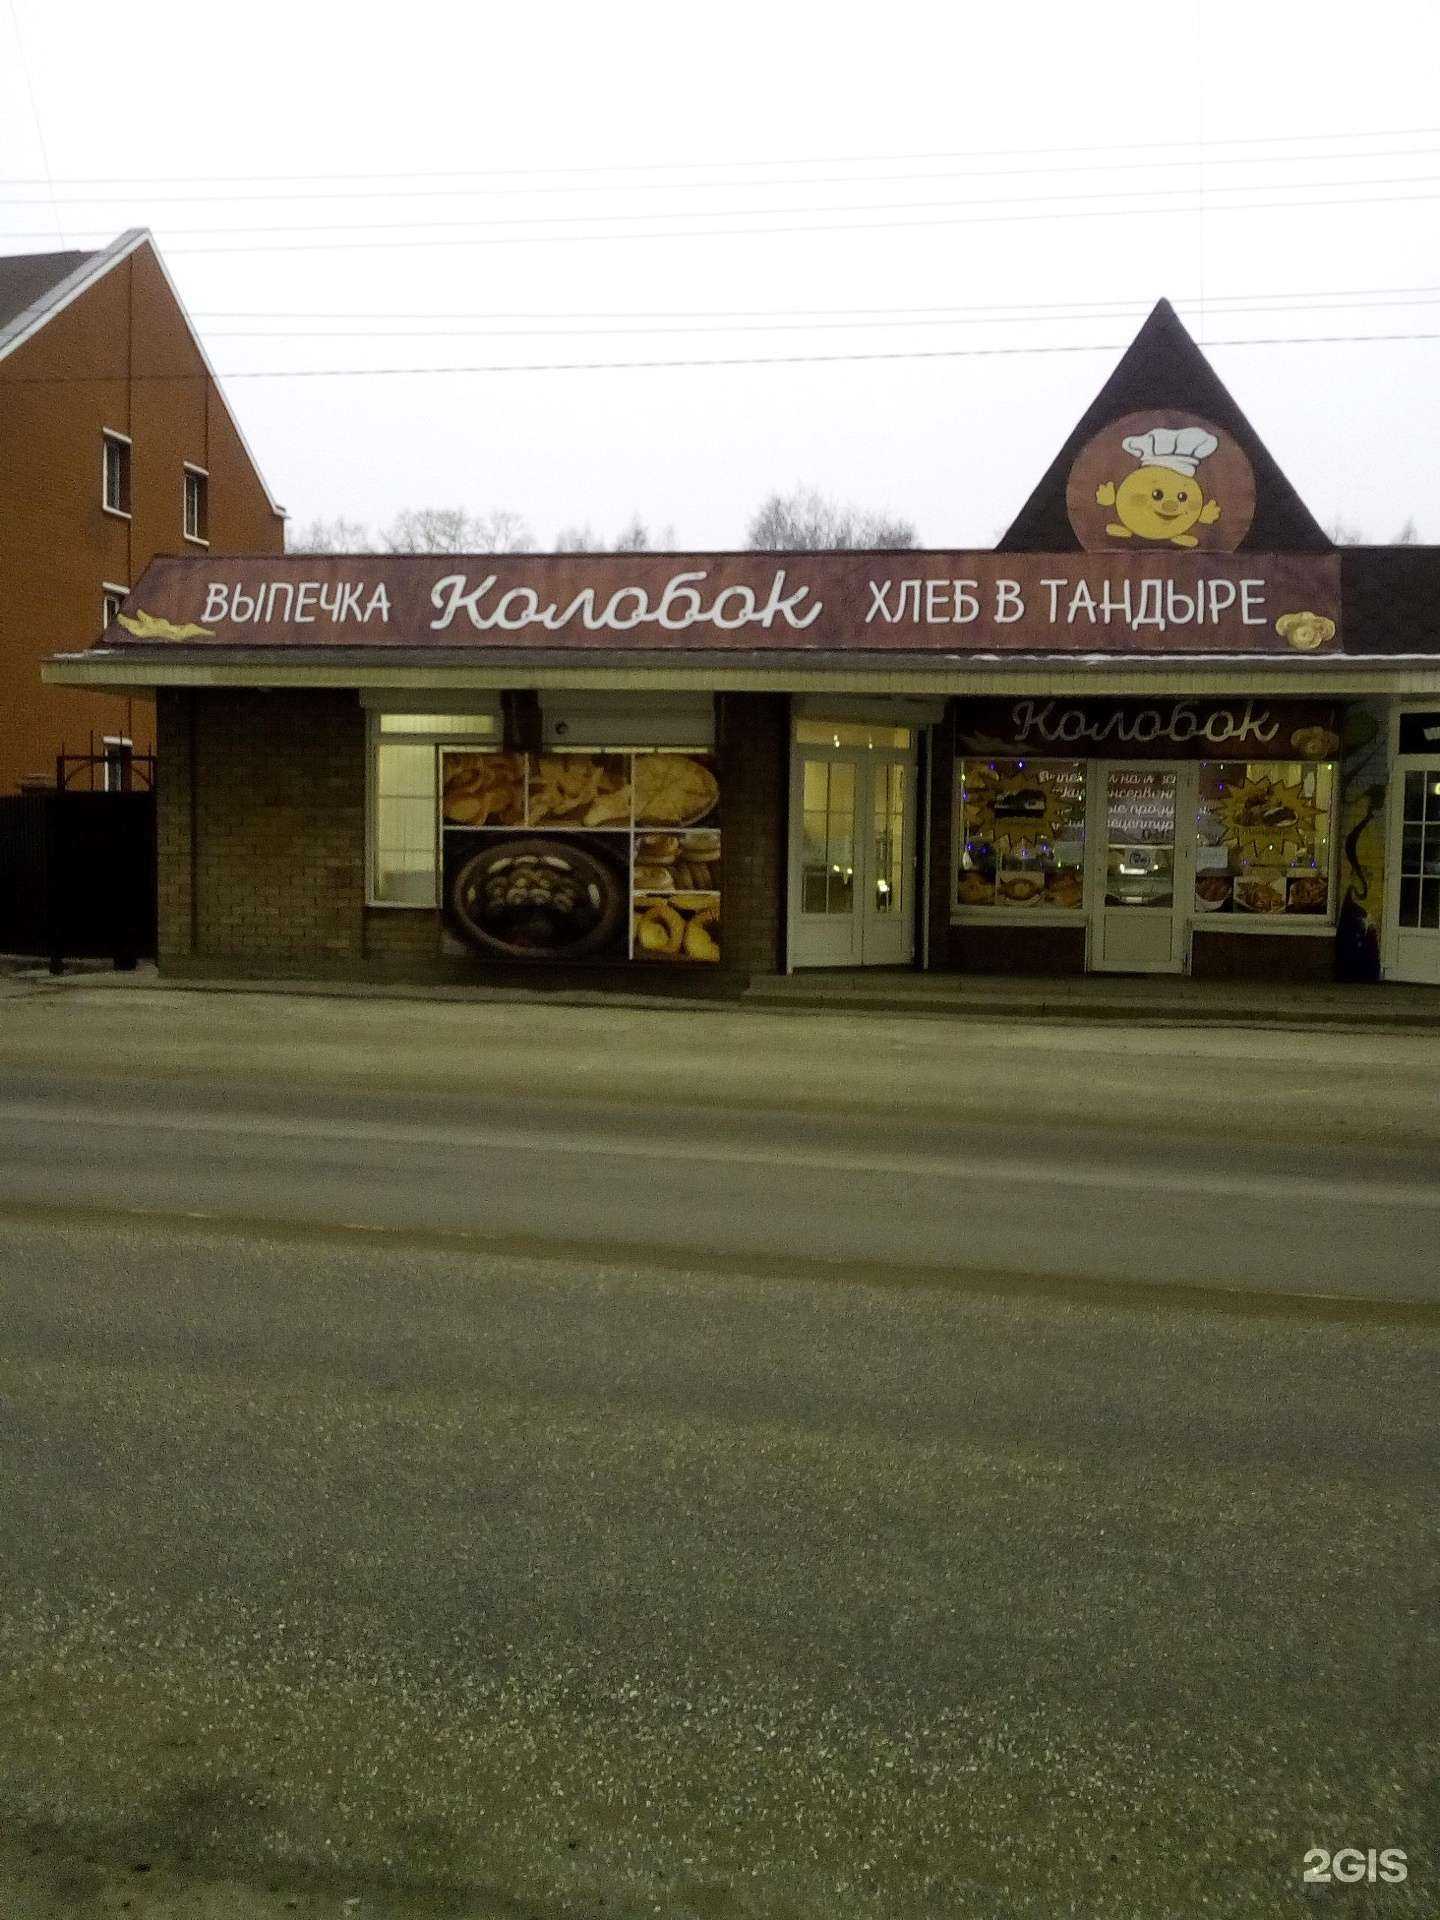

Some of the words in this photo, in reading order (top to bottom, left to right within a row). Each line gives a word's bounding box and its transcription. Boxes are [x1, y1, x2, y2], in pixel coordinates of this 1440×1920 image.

[201, 581, 391, 623] ВЫПЕЧКА
[430, 569, 823, 630] Колобок
[865, 579, 981, 624] ХЛЕБ
[994, 579, 1026, 624] В
[1040, 578, 1268, 632] ТАНДЫРЕ
[1011, 699, 1279, 743] Колобок
